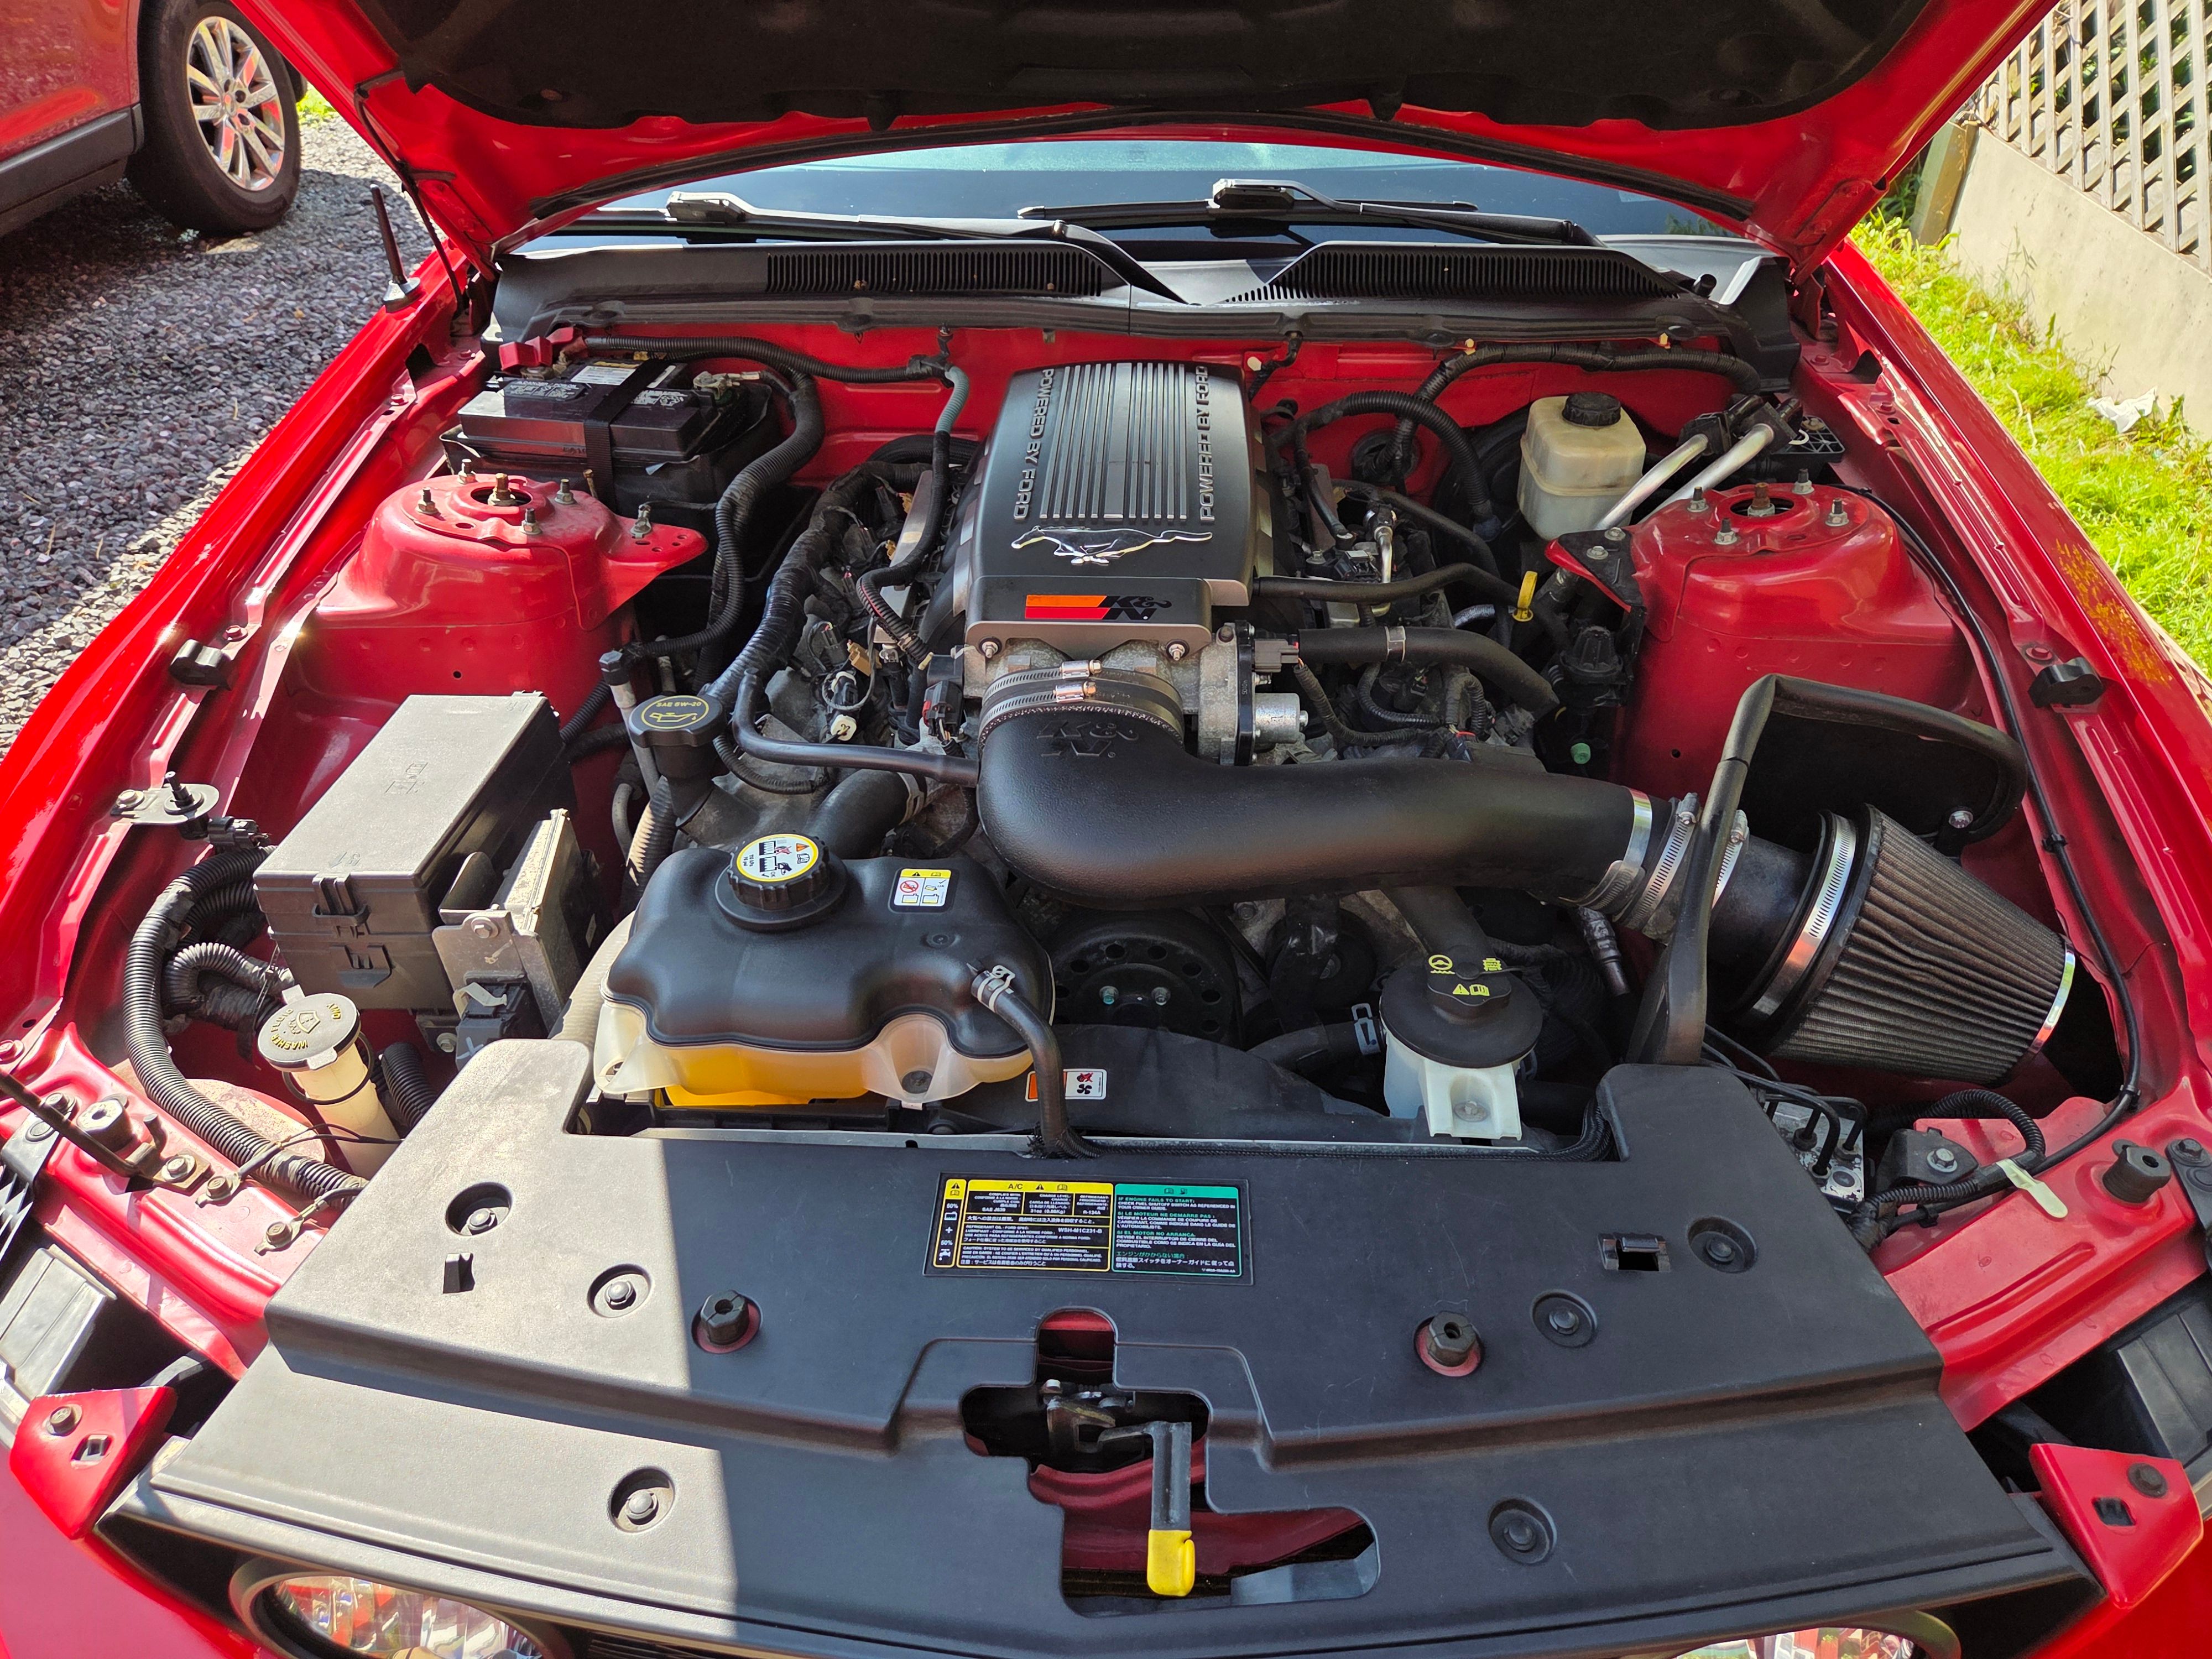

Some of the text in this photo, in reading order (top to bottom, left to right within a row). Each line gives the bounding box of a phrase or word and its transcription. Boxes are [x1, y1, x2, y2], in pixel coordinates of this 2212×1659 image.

[1014, 369, 1054, 519] POWERED BY FORD
[1196, 366, 1215, 521] POWERED BY FORD
[270, 1008, 308, 1050] WASHER FLUID
[326, 1002, 341, 1020] ONLY
